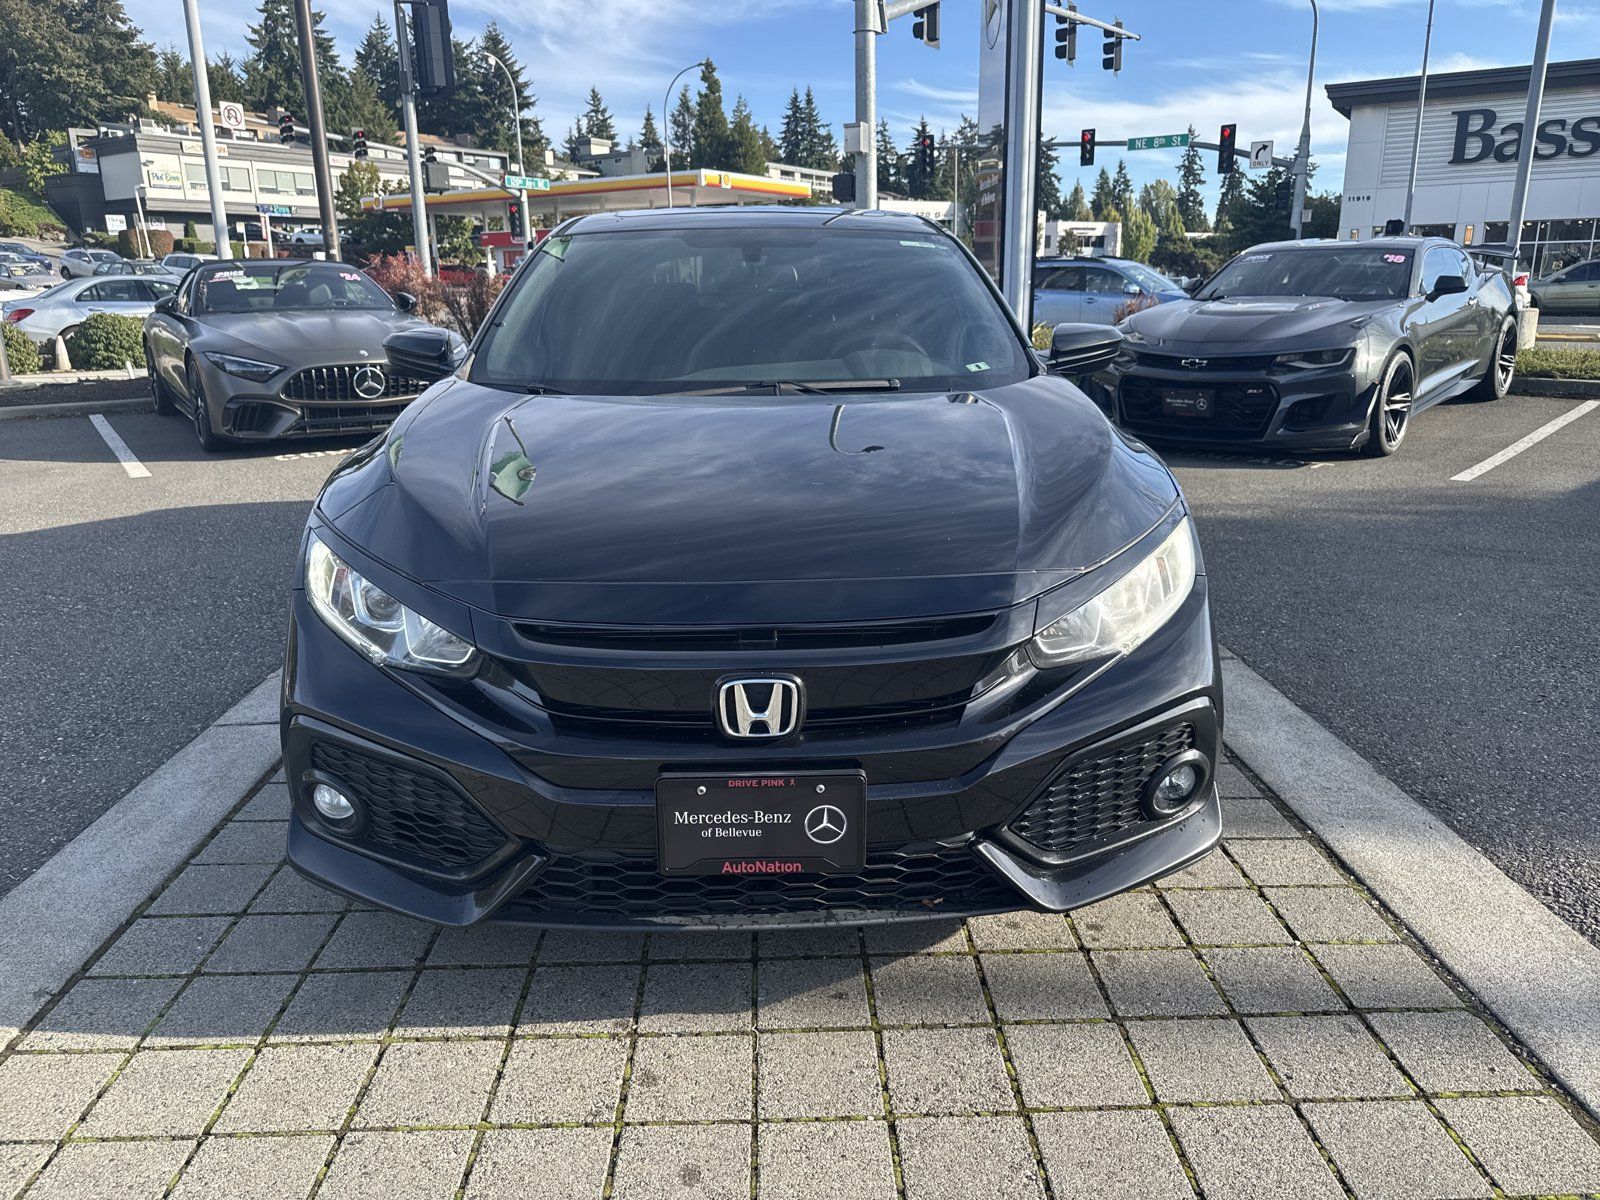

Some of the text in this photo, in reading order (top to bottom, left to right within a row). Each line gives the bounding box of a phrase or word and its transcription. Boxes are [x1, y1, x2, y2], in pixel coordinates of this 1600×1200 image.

[1135, 136, 1181, 149] NE 8th St
[728, 778, 785, 787] DRIVE PINK
[674, 810, 792, 825] Mercedes-Benz
[701, 827, 762, 838] of Bellevue
[721, 860, 803, 873] AutoNation
